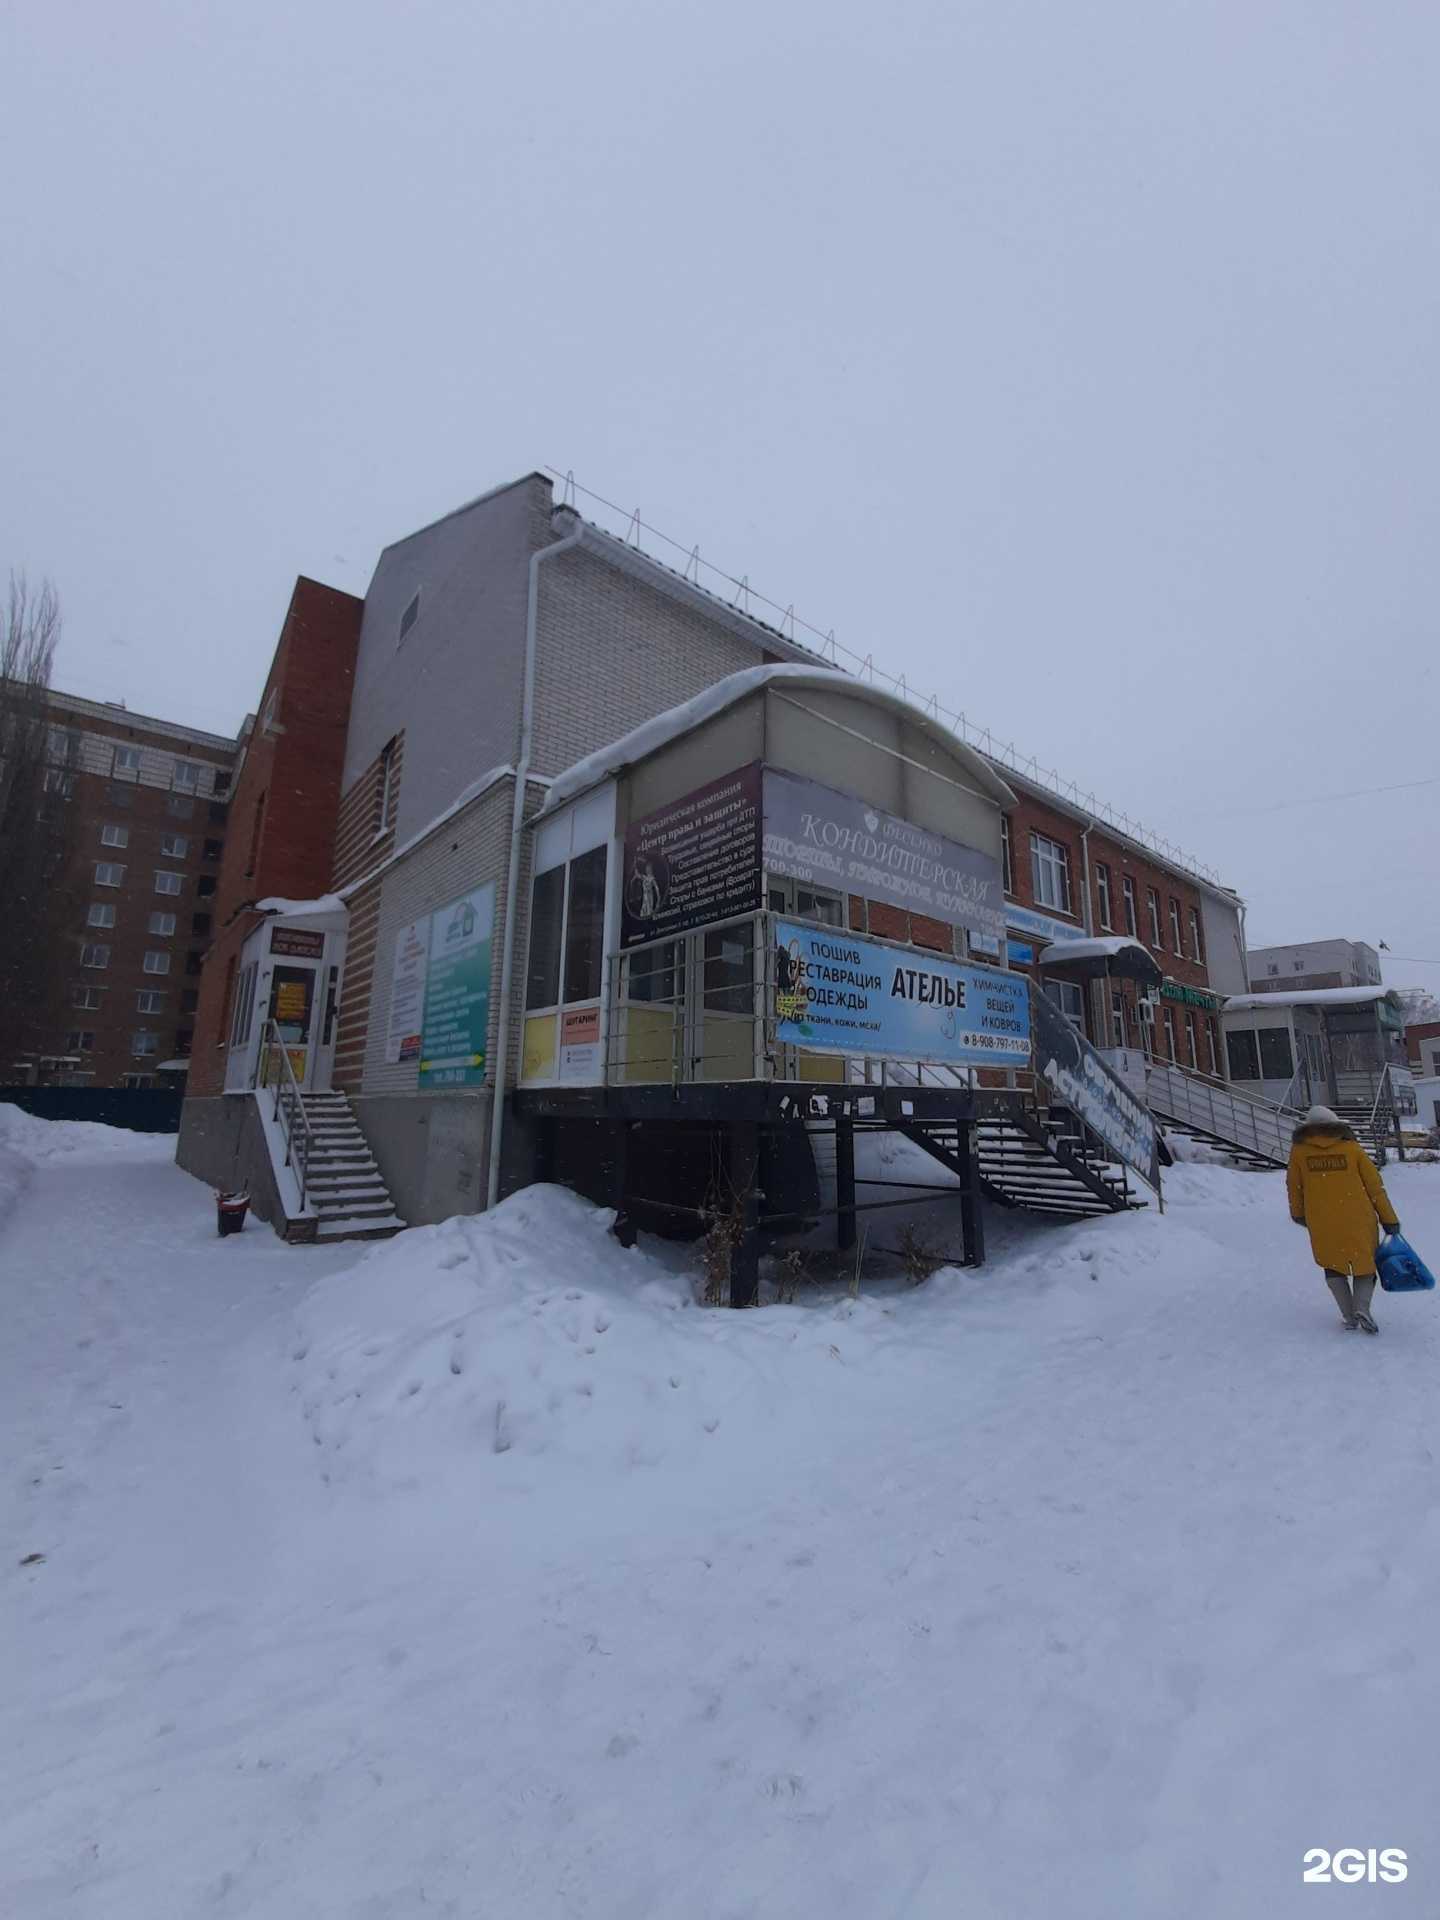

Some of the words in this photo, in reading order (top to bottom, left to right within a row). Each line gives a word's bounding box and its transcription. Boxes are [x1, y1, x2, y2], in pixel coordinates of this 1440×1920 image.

[801, 814, 992, 901] КОНДИТЕРСКАЯ
[810, 941, 861, 965] ПОШИВ
[789, 959, 882, 990] РЕСТАВРАЦИЯ
[806, 986, 868, 1012] ОДЕЖДЫ
[891, 967, 967, 1009] АТЕЛЬЕ
[972, 978, 1024, 998] ХИМЧИСТКА
[986, 998, 1015, 1014] ВЕЩЕЙ
[806, 1014, 833, 1025] ткани,
[989, 1016, 1022, 1033] КОВРОВ
